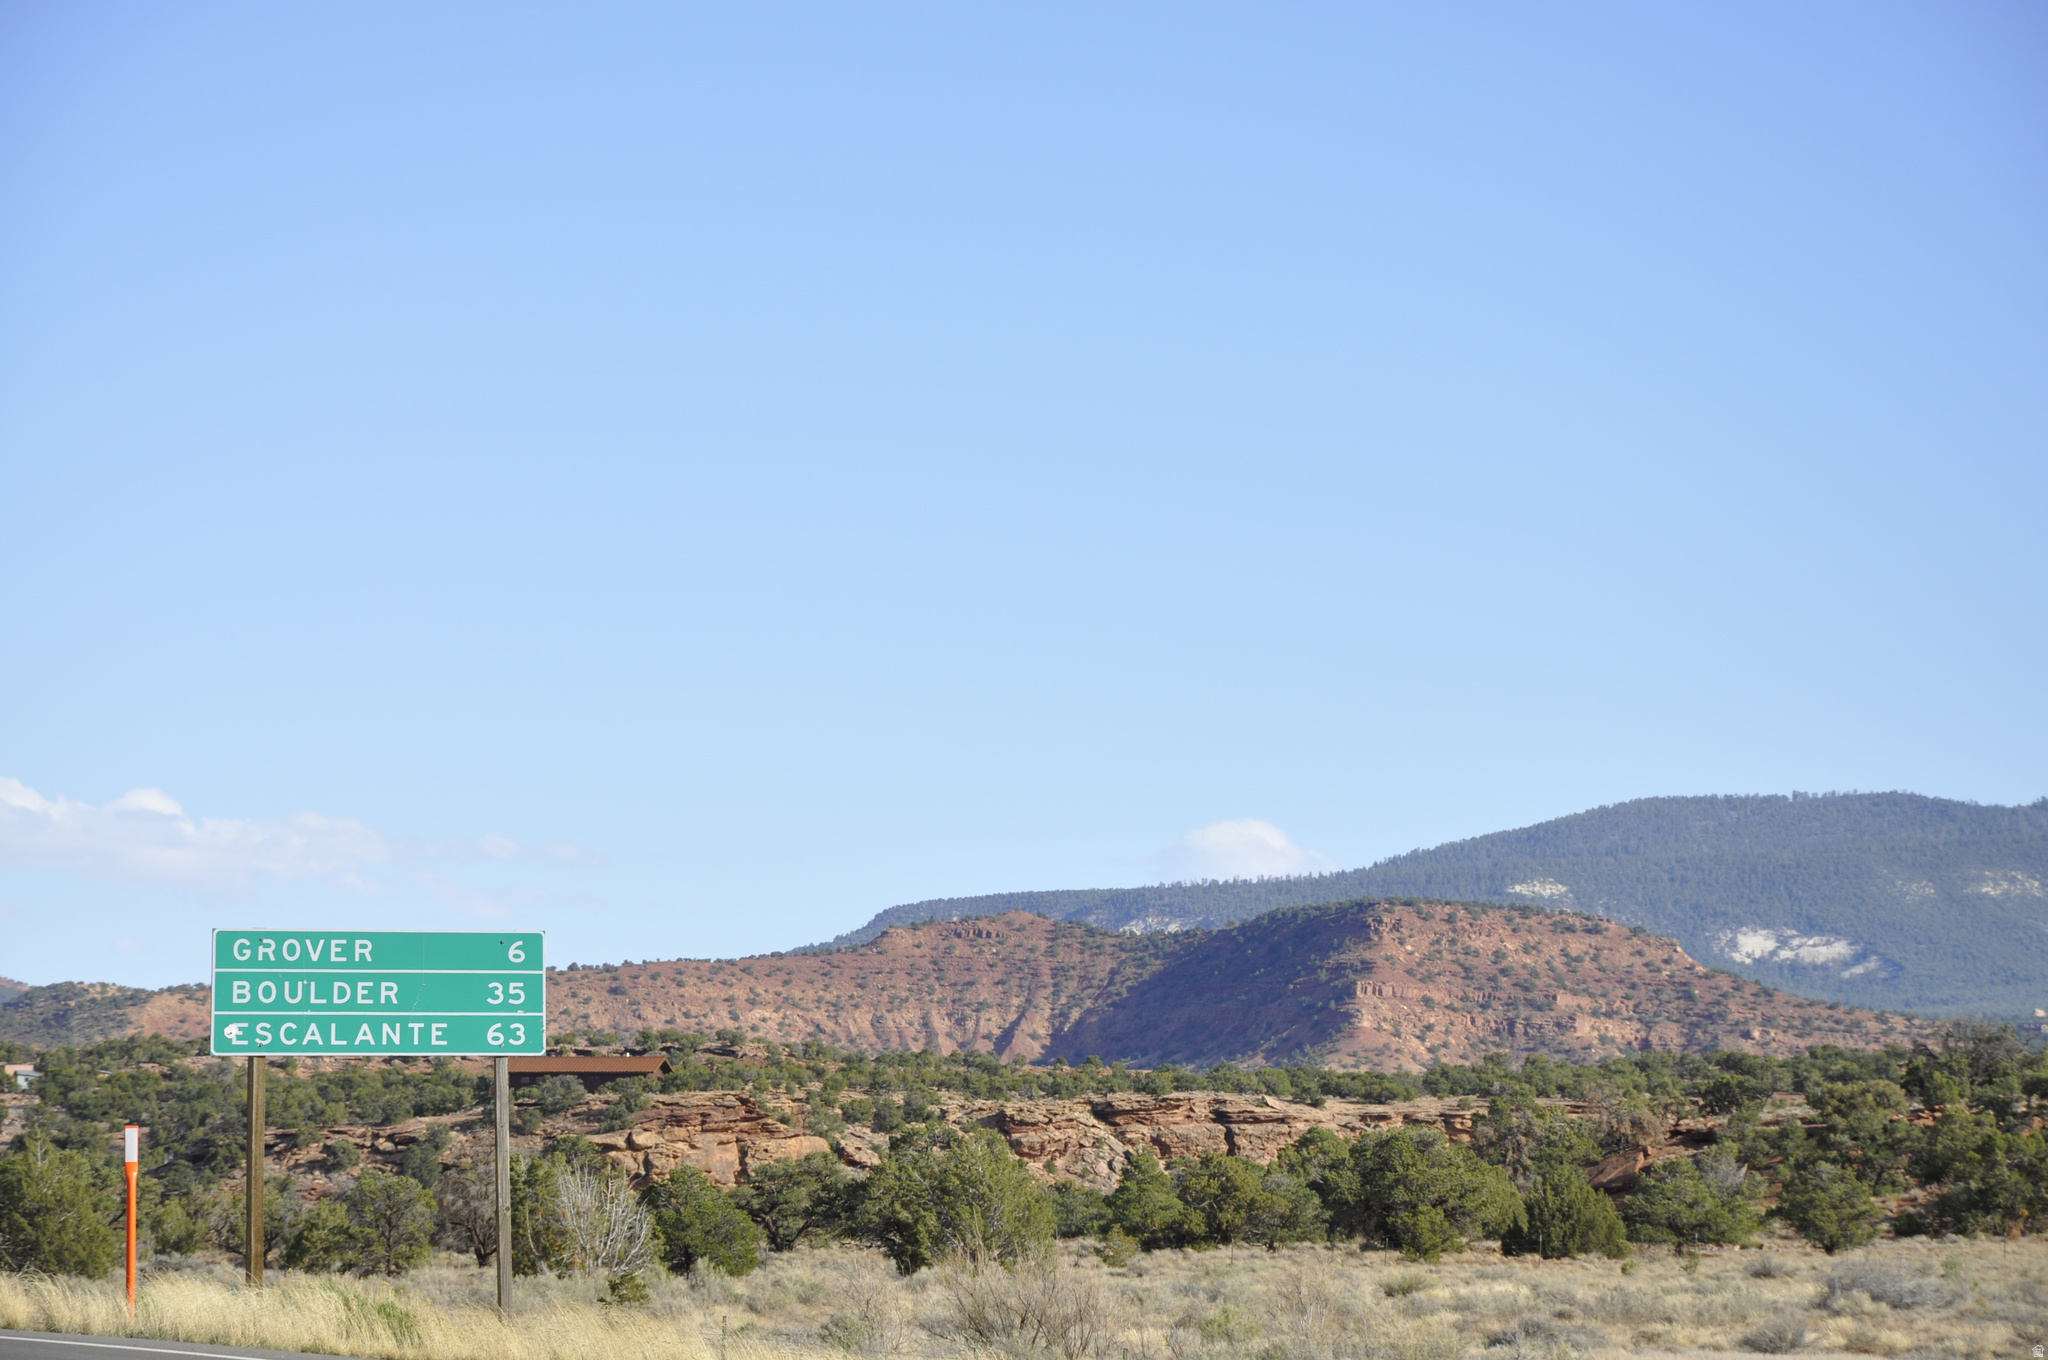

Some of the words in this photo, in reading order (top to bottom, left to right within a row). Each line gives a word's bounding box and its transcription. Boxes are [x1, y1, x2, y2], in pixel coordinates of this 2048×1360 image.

[233, 938, 373, 962] GROVER
[508, 940, 526, 963] 6
[232, 980, 399, 1004] BOULDER
[486, 982, 526, 1005] 35
[231, 1022, 448, 1046] ESCALANTE
[486, 1022, 526, 1046] 63
